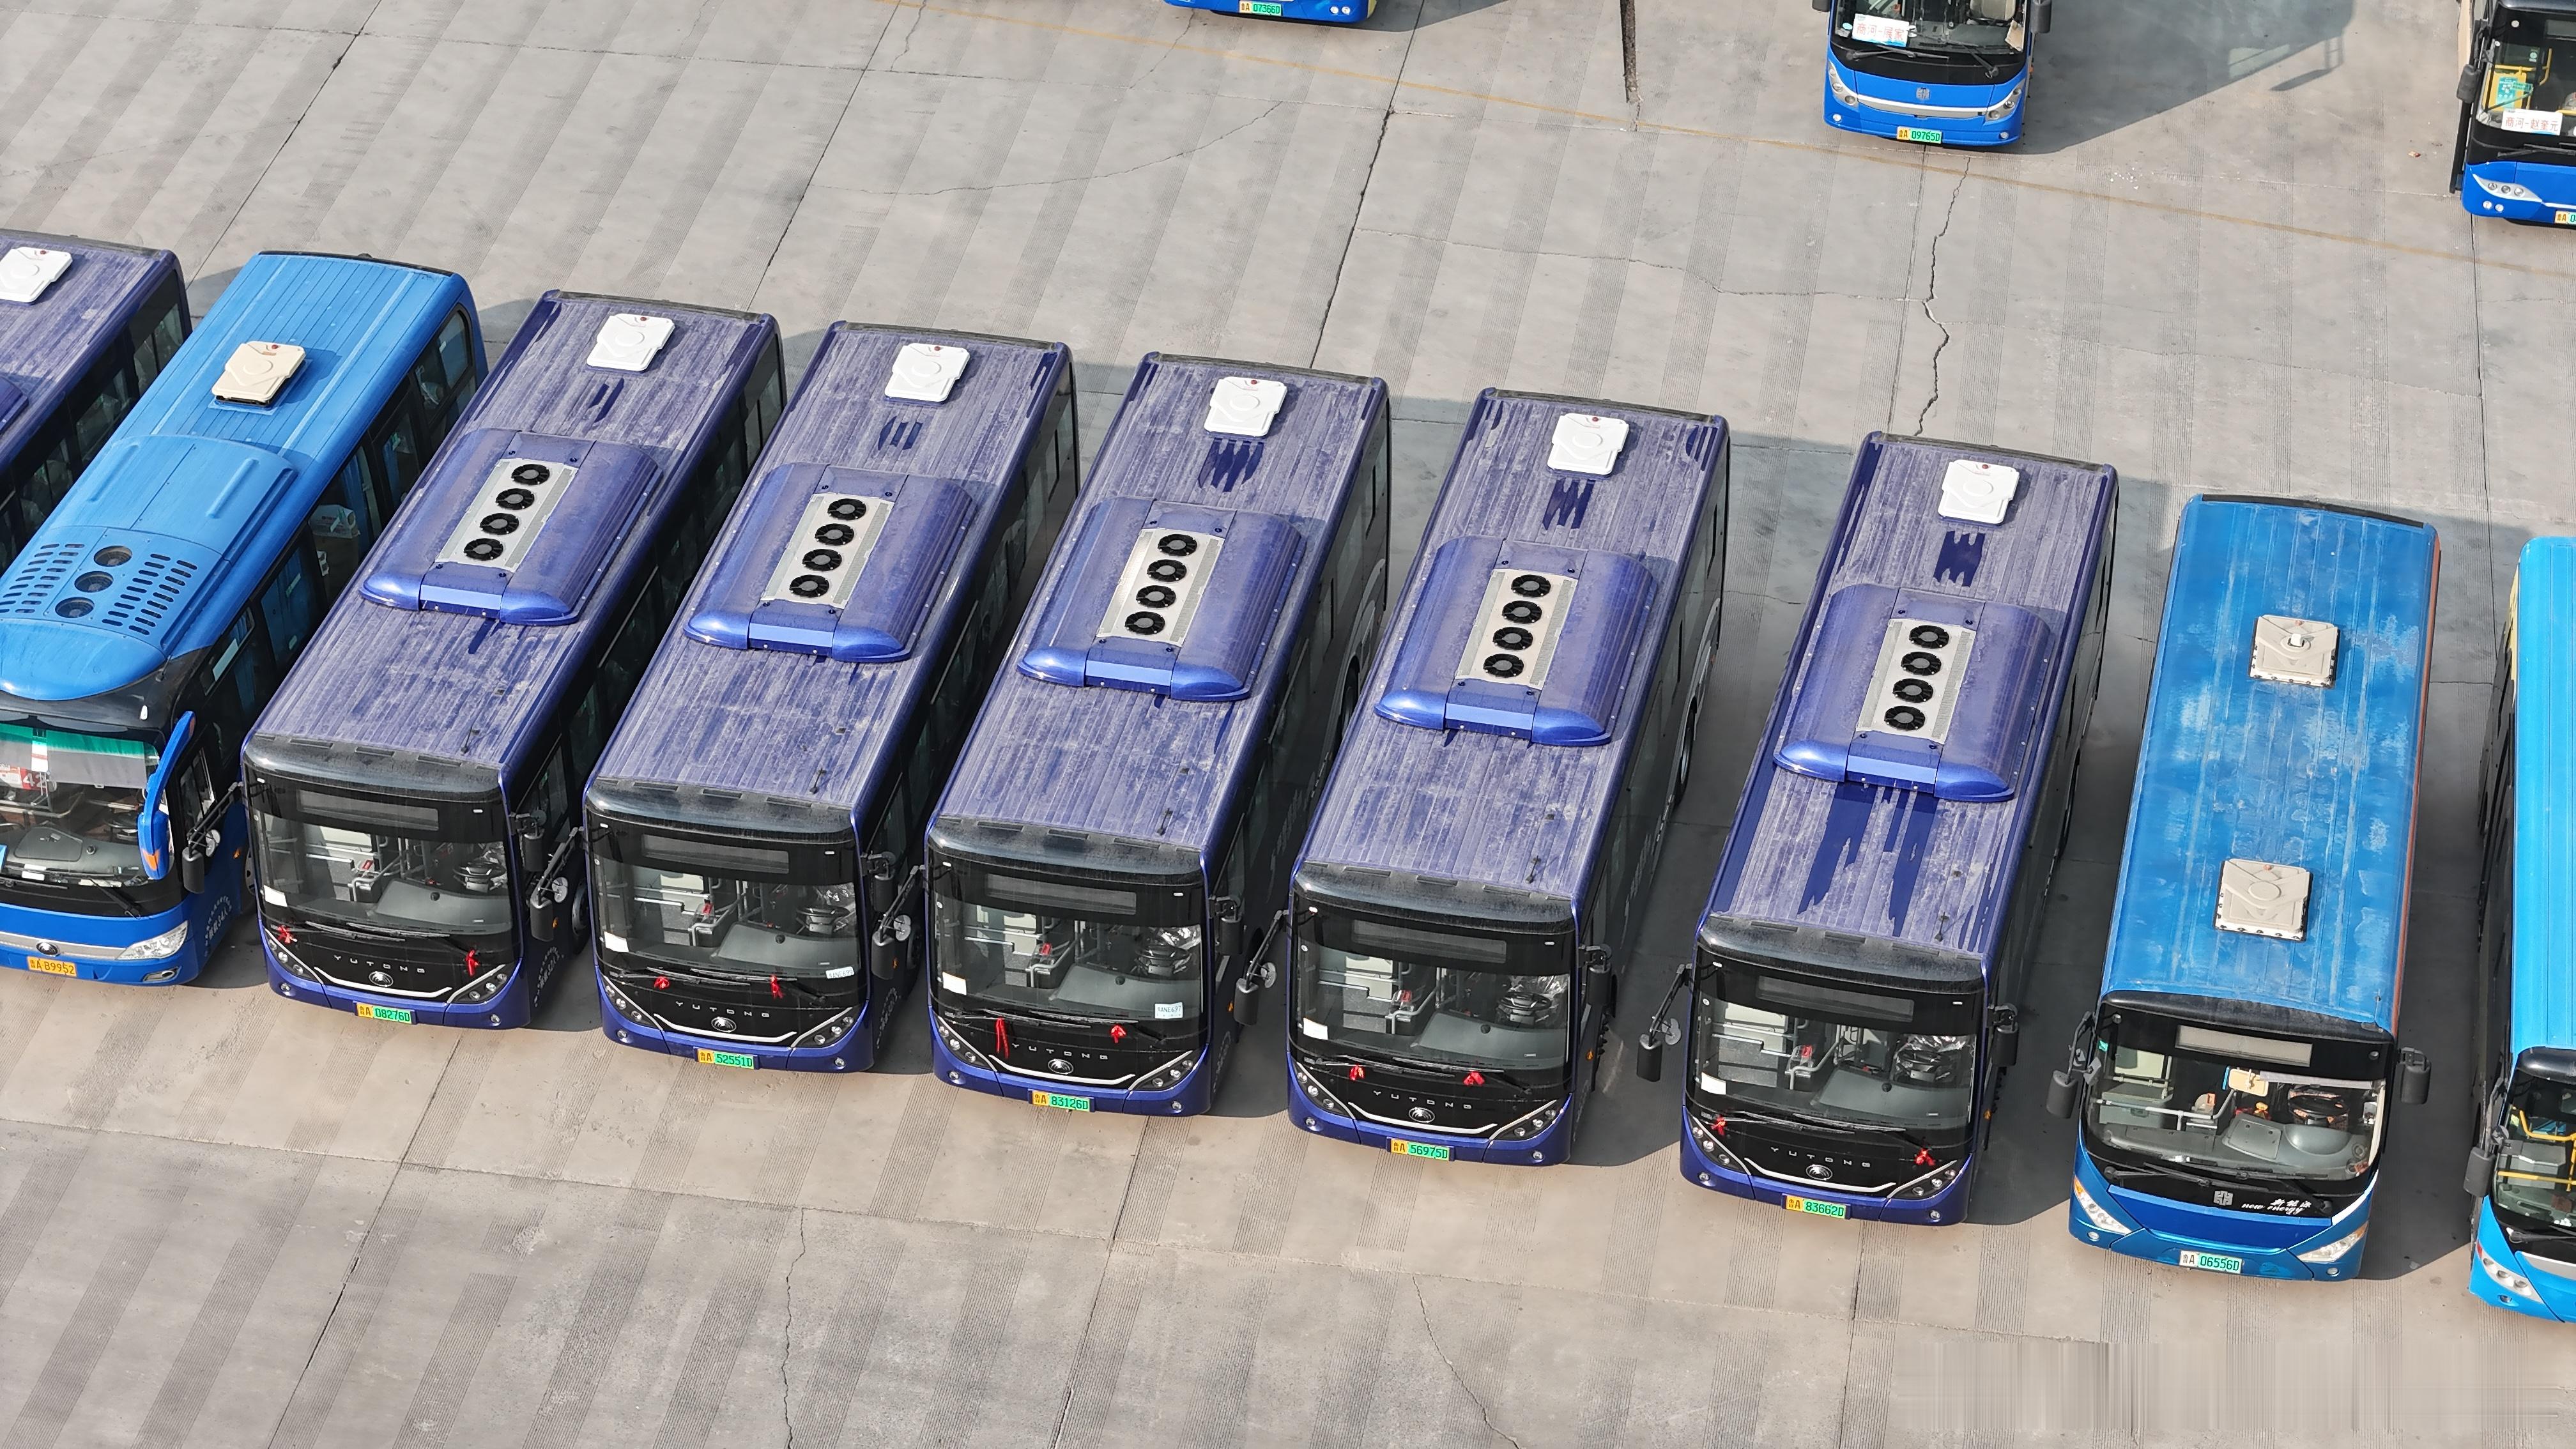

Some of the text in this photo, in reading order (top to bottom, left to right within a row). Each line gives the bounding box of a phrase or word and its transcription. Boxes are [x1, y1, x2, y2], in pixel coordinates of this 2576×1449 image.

[334, 954, 425, 974] YUTONG
[675, 1001, 770, 1018] YUTONG
[1011, 1043, 1108, 1061] YUTONG
[1374, 1090, 1472, 1110] YUTONG
[1770, 1146, 1871, 1168] YUTONG
